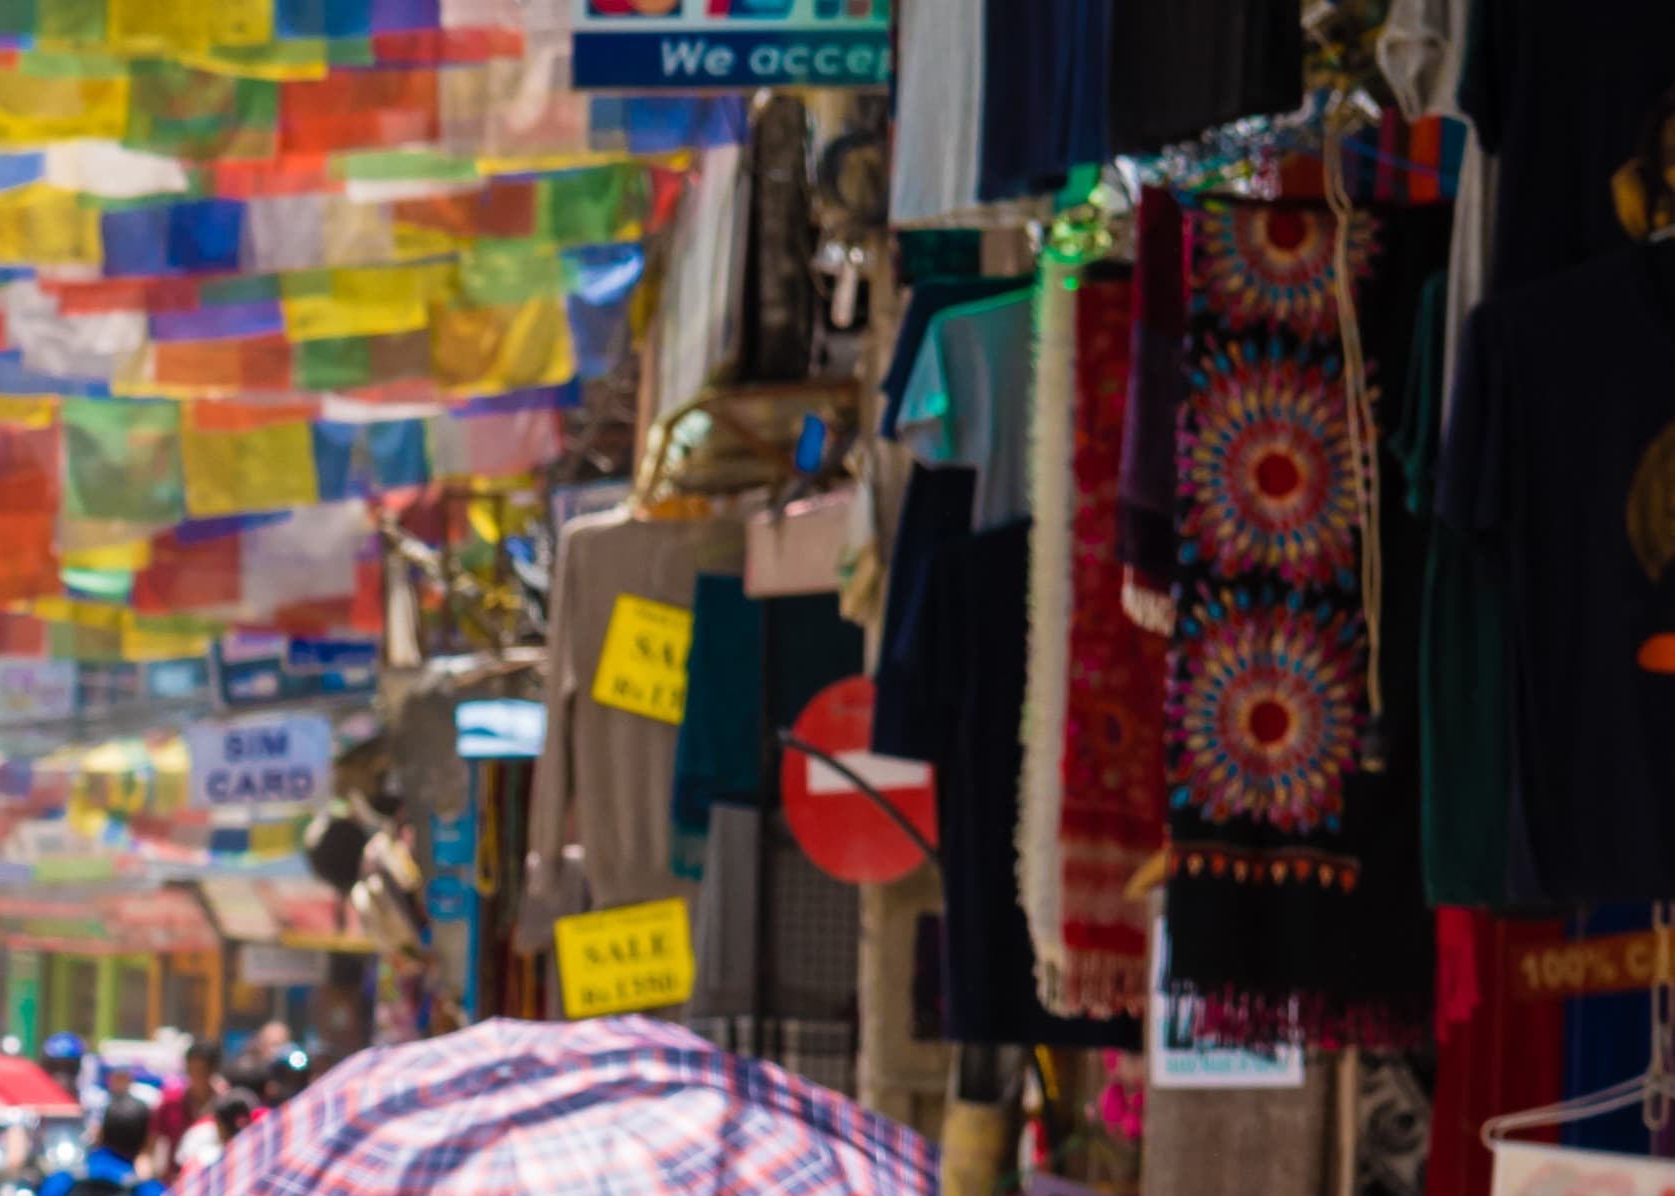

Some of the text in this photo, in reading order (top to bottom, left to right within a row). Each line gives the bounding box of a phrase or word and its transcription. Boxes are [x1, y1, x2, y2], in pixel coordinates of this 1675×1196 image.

[661, 39, 735, 77] We
[225, 728, 289, 763] SIM
[206, 767, 314, 804] CARD
[583, 932, 670, 968] SALE
[1521, 945, 1619, 990] 100%
